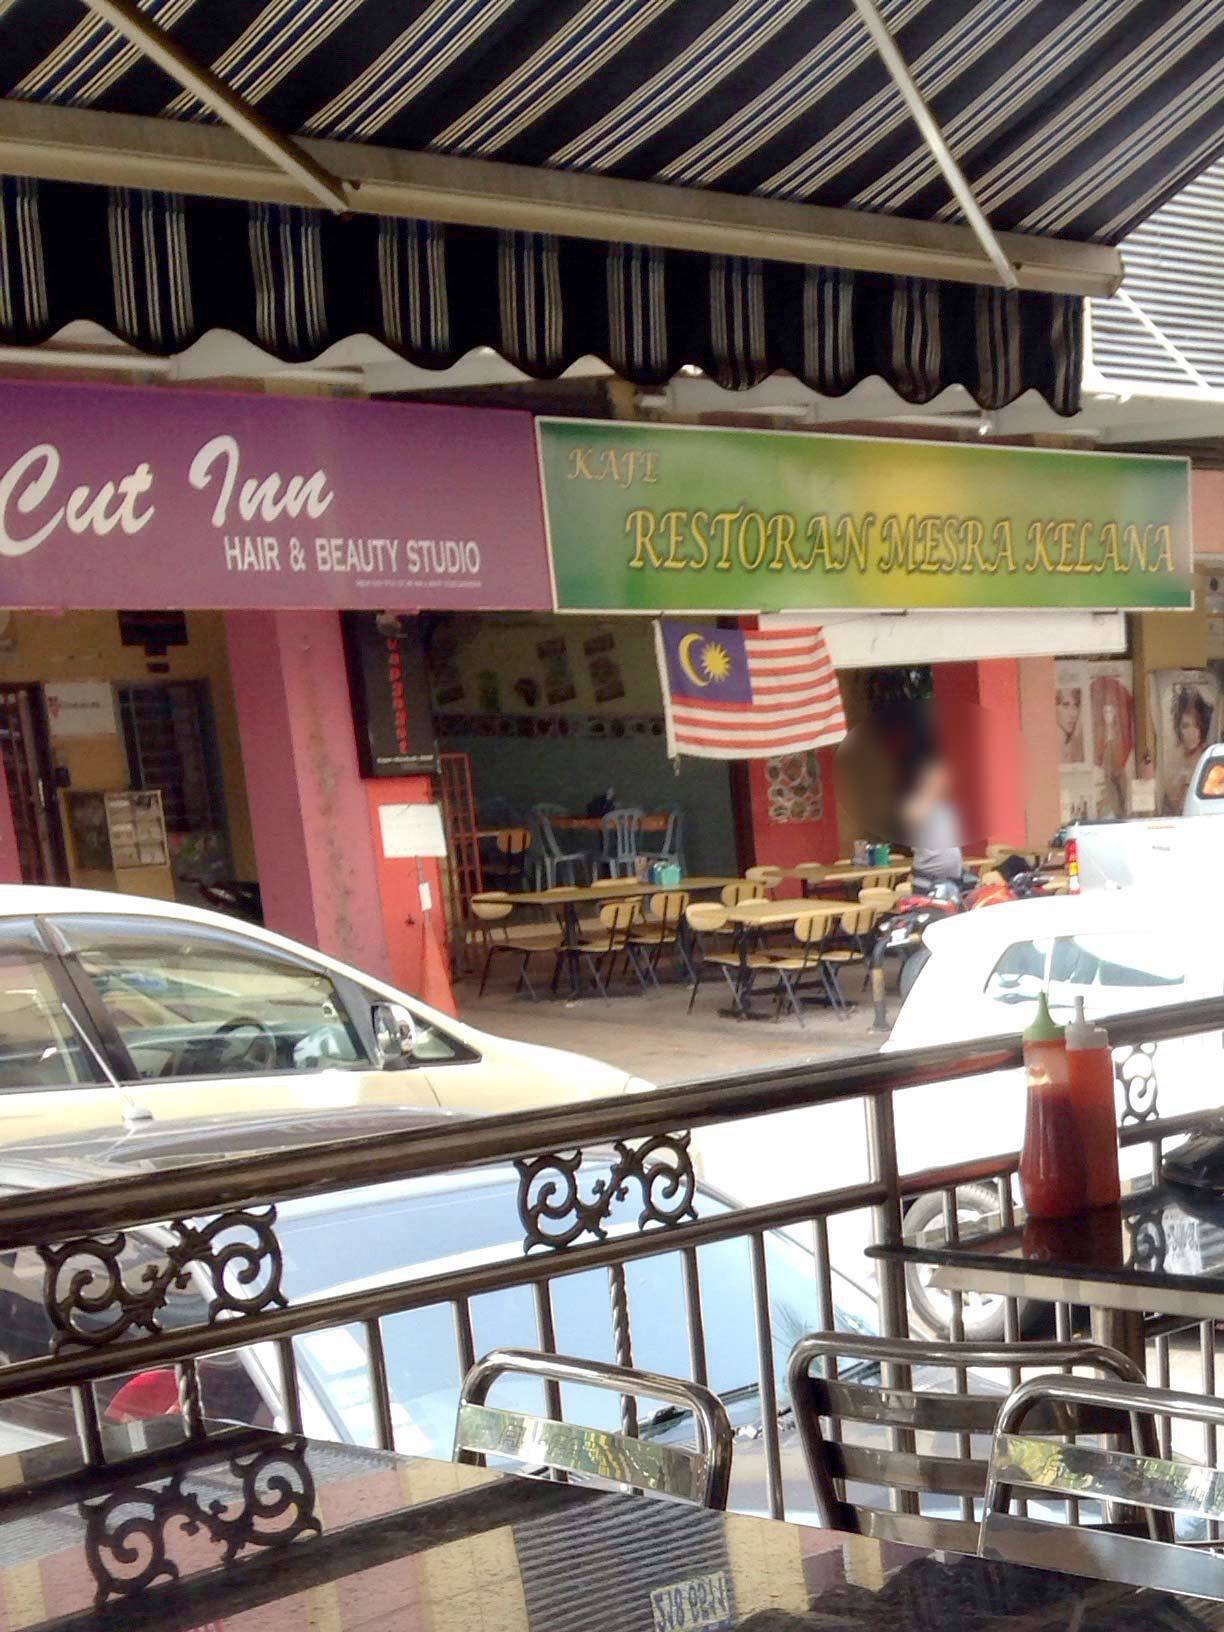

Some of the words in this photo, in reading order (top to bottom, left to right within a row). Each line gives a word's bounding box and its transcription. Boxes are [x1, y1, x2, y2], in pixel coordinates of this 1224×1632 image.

[0, 443, 155, 557] Cut
[189, 434, 334, 528] Inn
[224, 536, 281, 571] HAIR
[289, 537, 306, 572] &
[315, 538, 399, 572] BEAUTY
[406, 540, 481, 573] STUDIO
[625, 504, 876, 572] RESTORAN
[879, 513, 1017, 573] MESRA
[1025, 520, 1176, 573] KELANA
